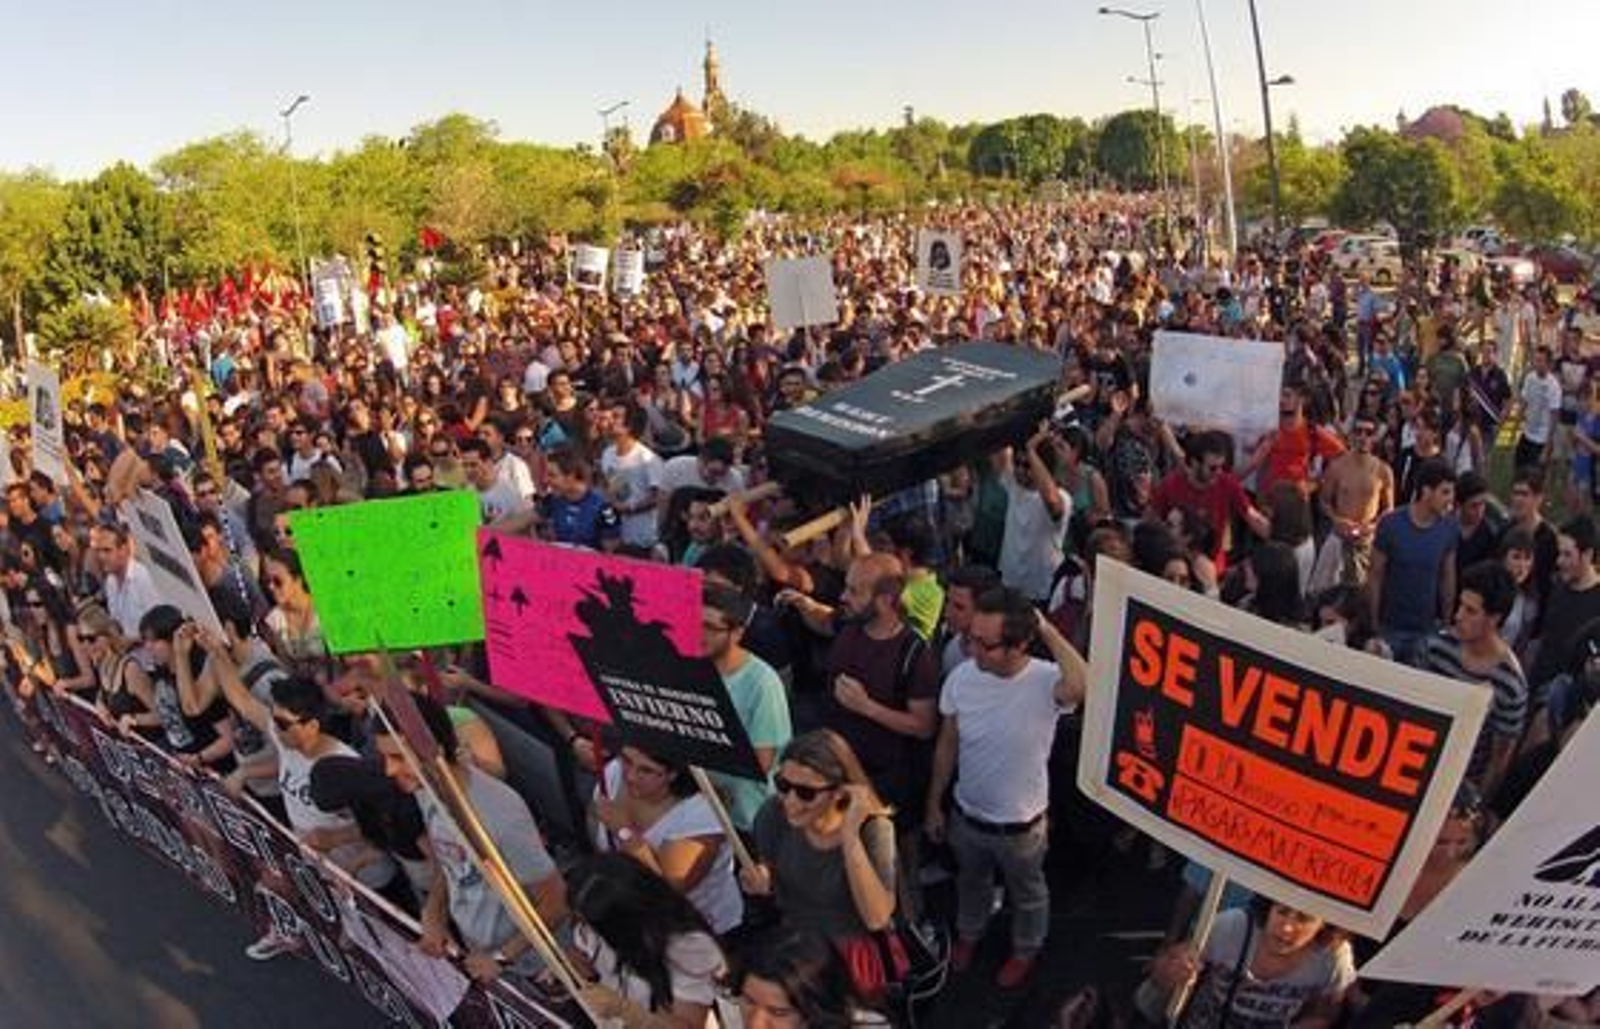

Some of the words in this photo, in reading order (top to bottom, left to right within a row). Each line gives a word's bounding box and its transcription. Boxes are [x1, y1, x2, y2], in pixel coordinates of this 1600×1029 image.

[607, 687, 724, 729] INFIERNO
[1130, 620, 1199, 706] SE
[1219, 654, 1438, 797] VENDE
[1513, 892, 1554, 908] NO
